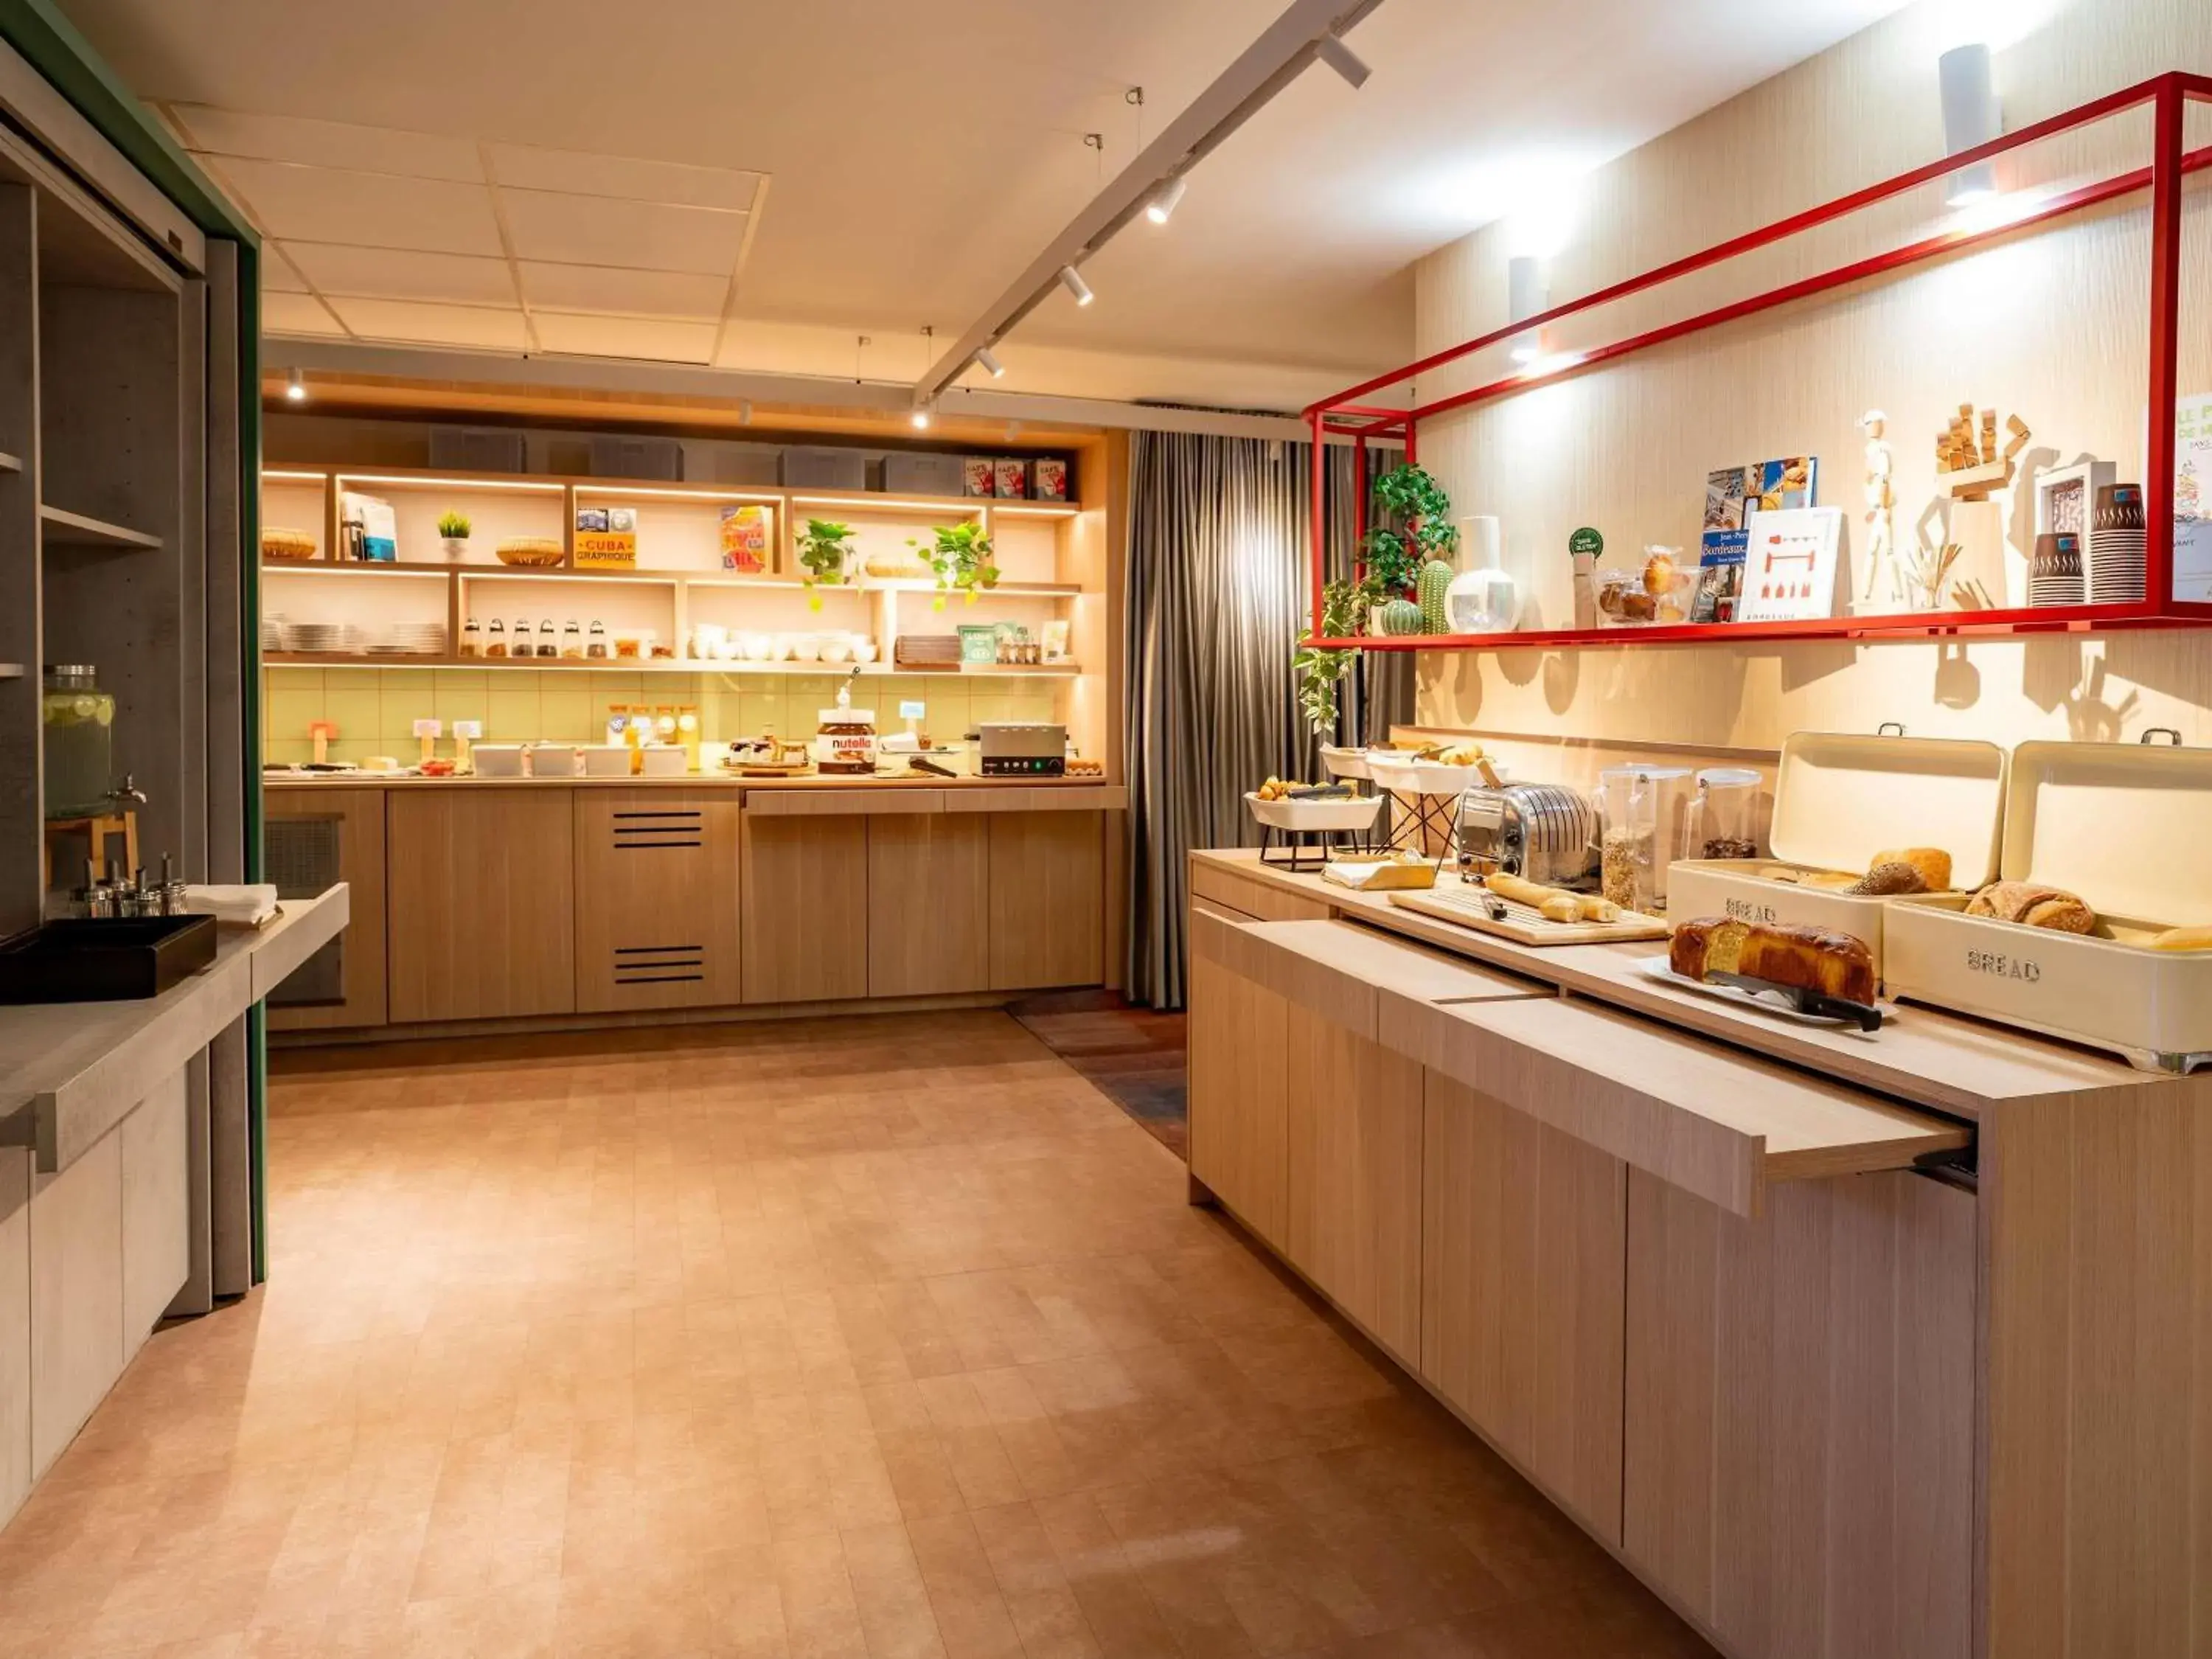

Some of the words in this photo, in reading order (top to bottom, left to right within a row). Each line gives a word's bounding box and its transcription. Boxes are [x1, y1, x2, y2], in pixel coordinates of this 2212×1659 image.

[585, 540, 626, 551] CUBA
[832, 737, 871, 748] nutella
[1726, 897, 1776, 922] BREAD
[1968, 949, 2040, 983] BREAD
